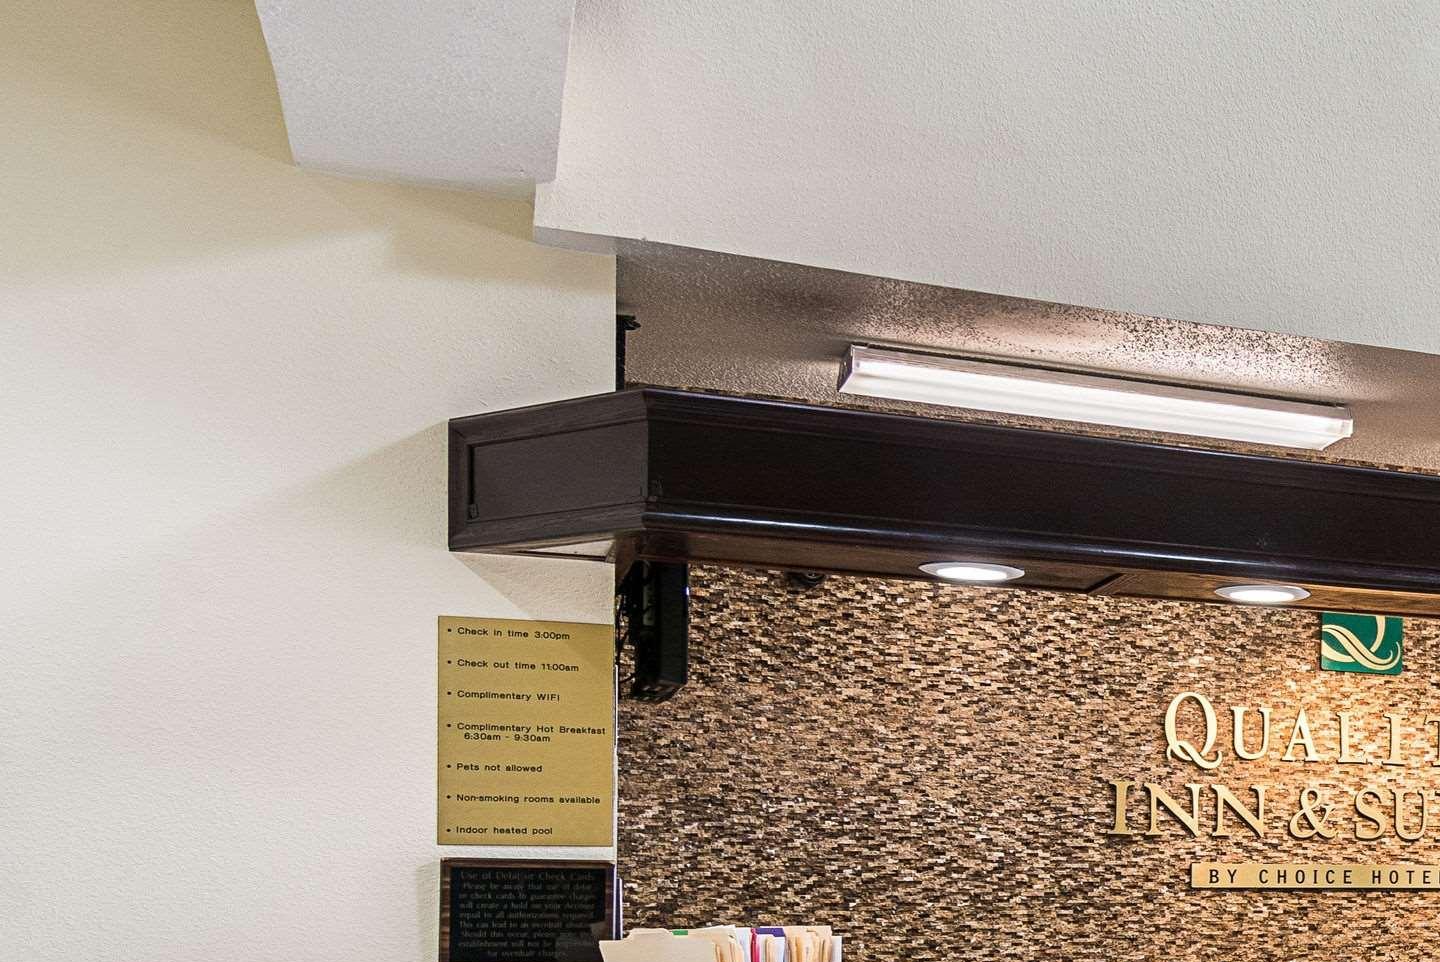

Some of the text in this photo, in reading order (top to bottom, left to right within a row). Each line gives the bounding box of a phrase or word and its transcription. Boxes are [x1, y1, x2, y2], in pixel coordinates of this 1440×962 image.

[457, 626, 570, 641] Check in time 3:00pm
[457, 658, 579, 672] Check out time 11:00am
[457, 690, 531, 702] Complimentary
[457, 722, 606, 735] Complimentary Hot Breakfast
[464, 732, 501, 741] 6:30am
[514, 733, 551, 742] 9:30am
[456, 763, 543, 773] Pets not allowed
[456, 793, 601, 805] Non-smoking rooms available
[1107, 780, 1266, 838] INN
[1289, 786, 1338, 840] &
[456, 826, 553, 836] Indoor heated pool
[1208, 869, 1238, 884] BY
[1258, 869, 1353, 885] CHOICE
